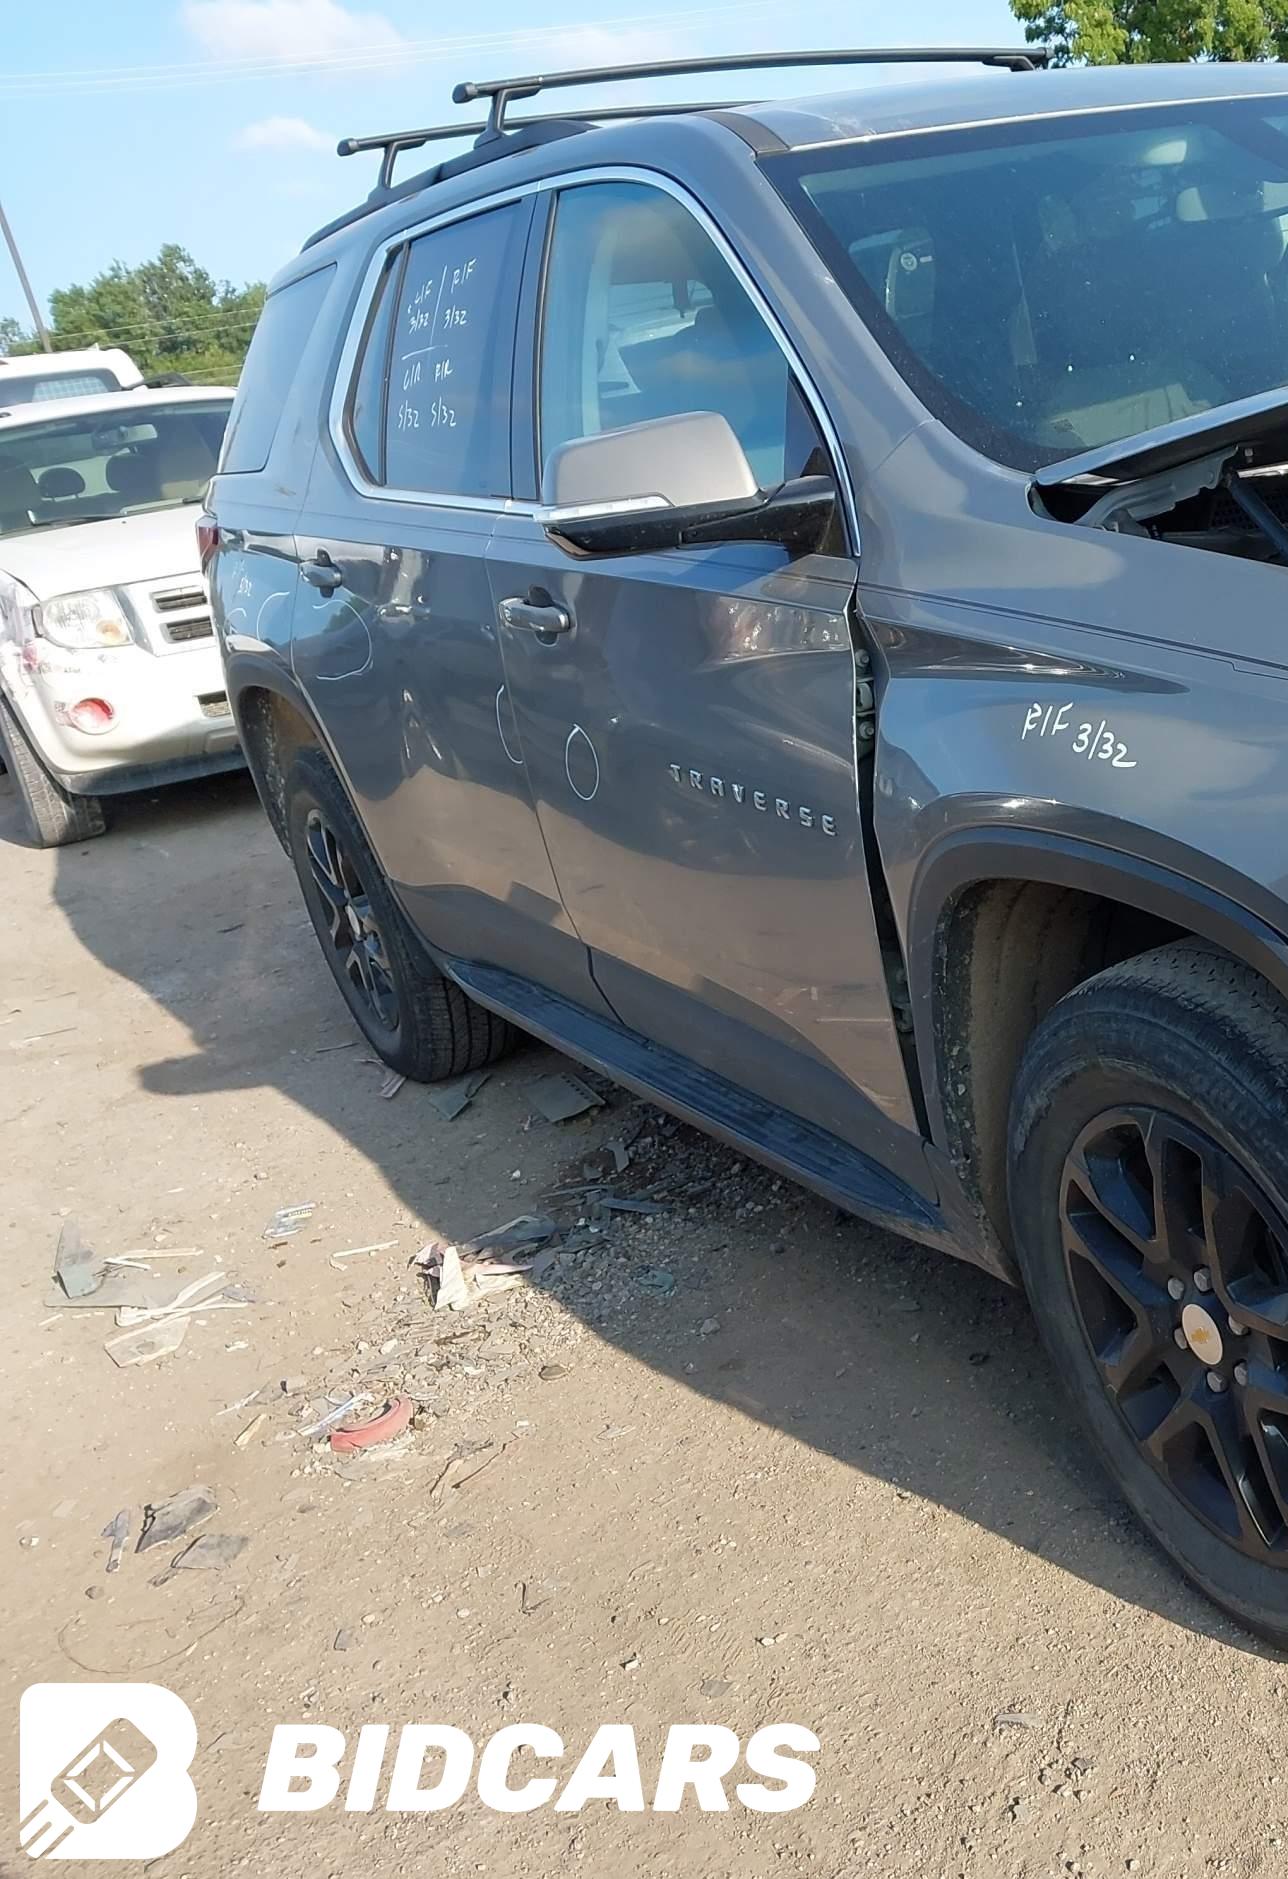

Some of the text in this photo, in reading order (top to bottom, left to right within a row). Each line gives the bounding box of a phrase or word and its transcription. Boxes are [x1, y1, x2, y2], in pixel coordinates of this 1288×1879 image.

[443, 304, 468, 330] 3/32
[1072, 720, 1137, 768] 3/32
[669, 763, 838, 836] TRAVERSE
